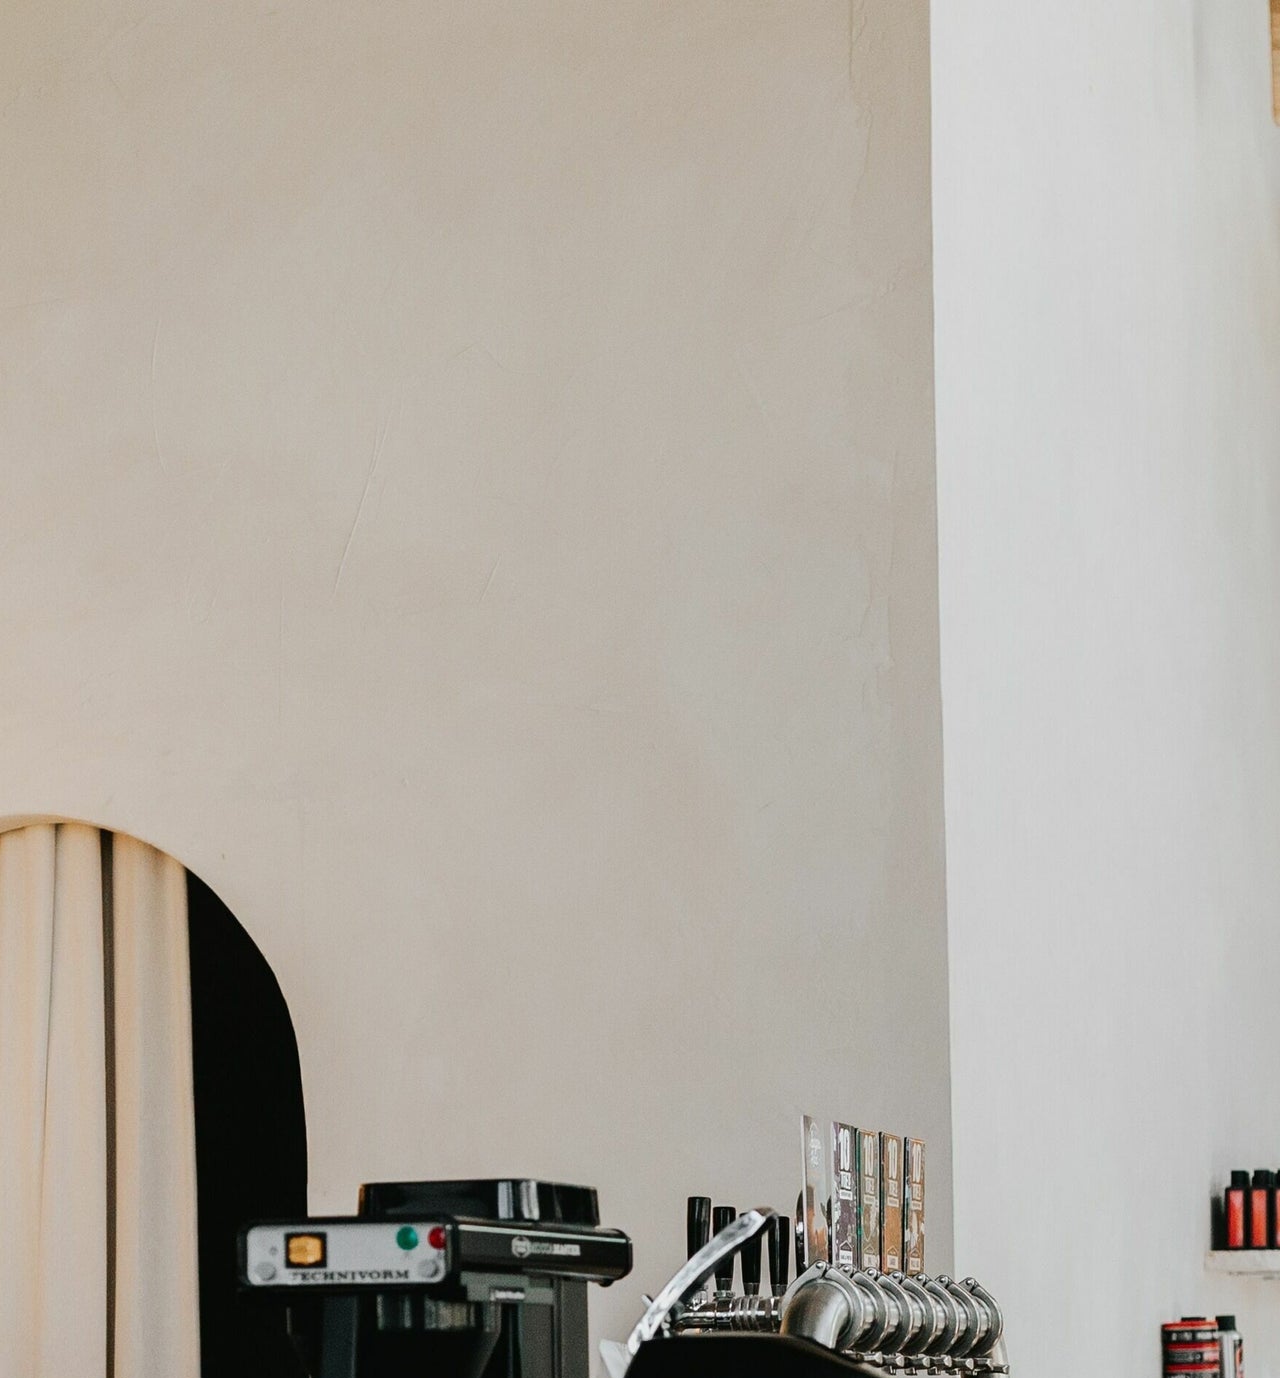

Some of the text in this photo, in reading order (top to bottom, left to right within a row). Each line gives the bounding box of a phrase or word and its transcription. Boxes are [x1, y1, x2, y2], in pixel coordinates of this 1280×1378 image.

[839, 1128, 850, 1171] 10
[864, 1134, 874, 1177] 10
[888, 1138, 897, 1180] 10
[912, 1143, 921, 1183] 10
[292, 1270, 409, 1281] TECHNIVORM
